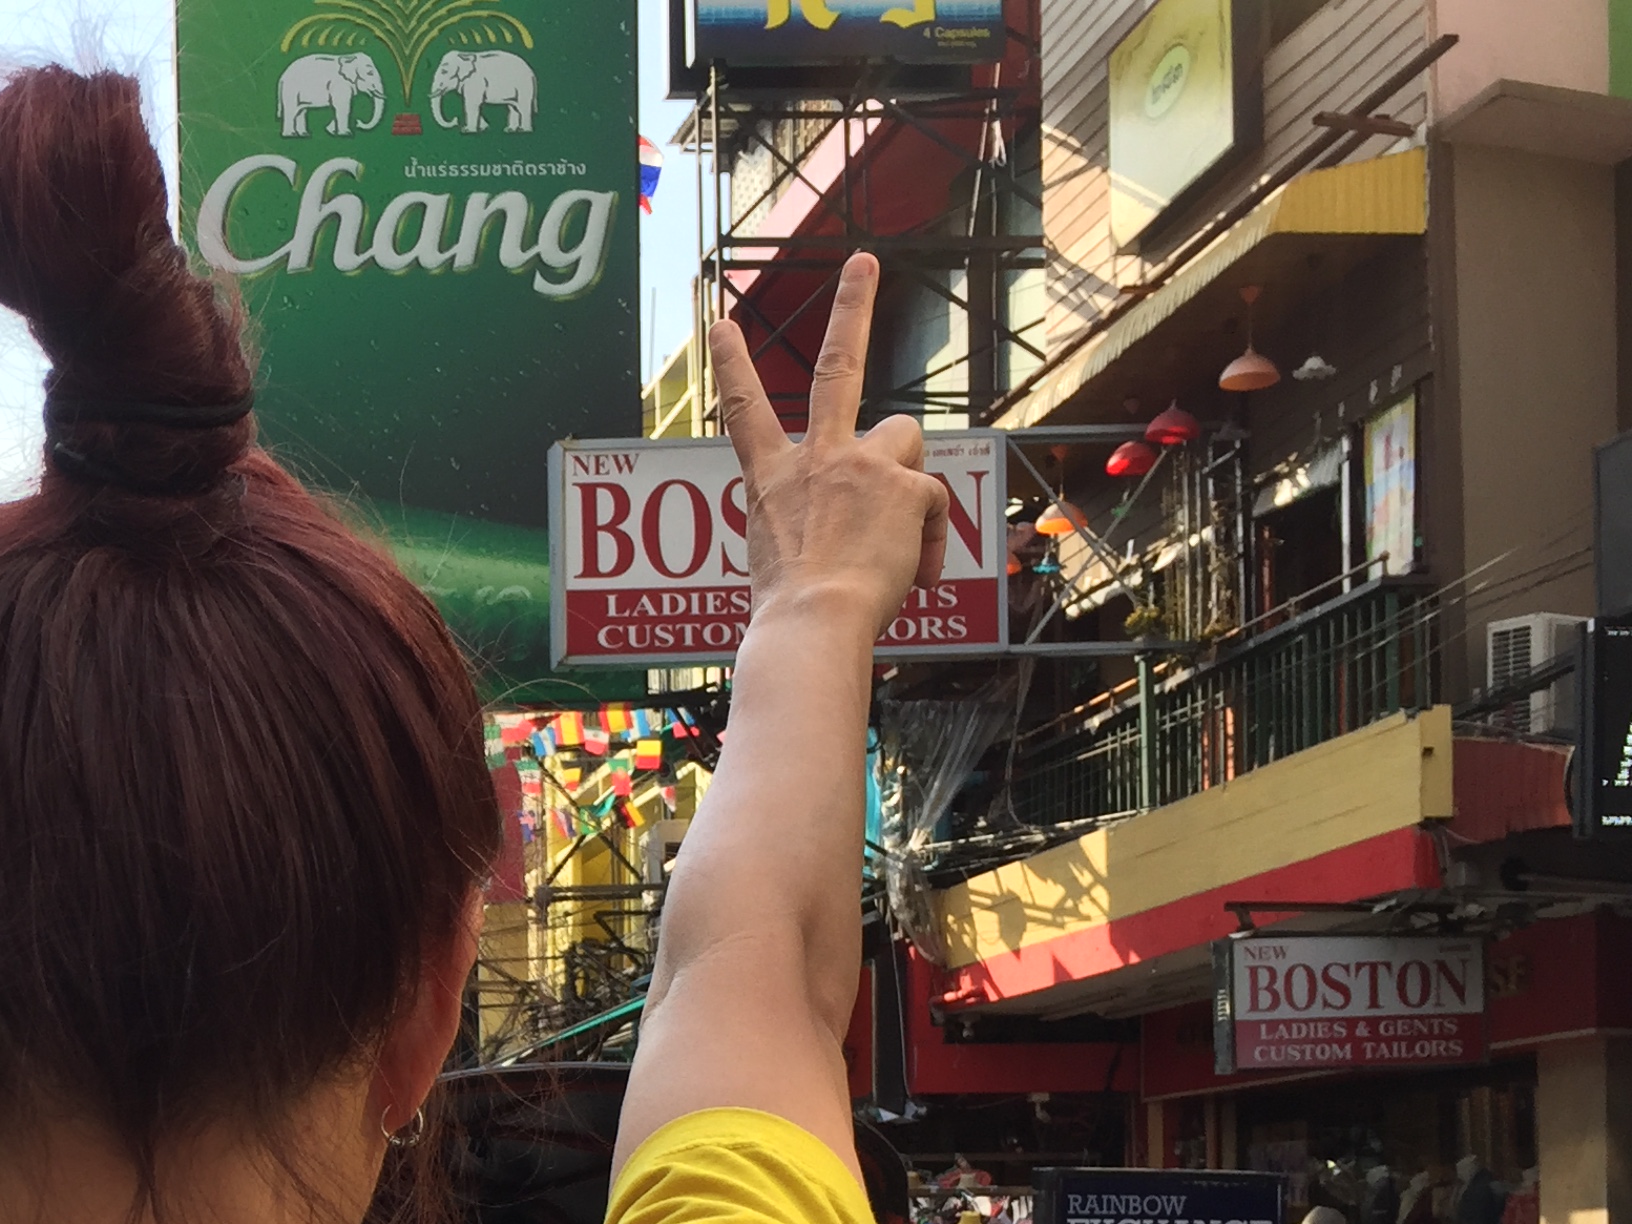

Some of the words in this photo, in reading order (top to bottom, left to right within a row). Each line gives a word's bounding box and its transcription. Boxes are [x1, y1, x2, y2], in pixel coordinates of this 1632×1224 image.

[404, 157, 587, 178] น้ำแร่ธรรมชาติตราช้าง
[196, 154, 619, 298] Chang
[572, 454, 640, 476] NEW
[606, 591, 751, 618] LADIES
[1244, 945, 1288, 961] NEW
[1244, 958, 1471, 1014] BOSTON
[1260, 1021, 1348, 1040] LADIES
[1355, 1020, 1370, 1037] &
[1378, 1017, 1459, 1037] GENTS
[1254, 1042, 1353, 1062] CUSTOM
[1363, 1040, 1464, 1059] TAILORS
[1068, 1195, 1187, 1216] RAINBOW
